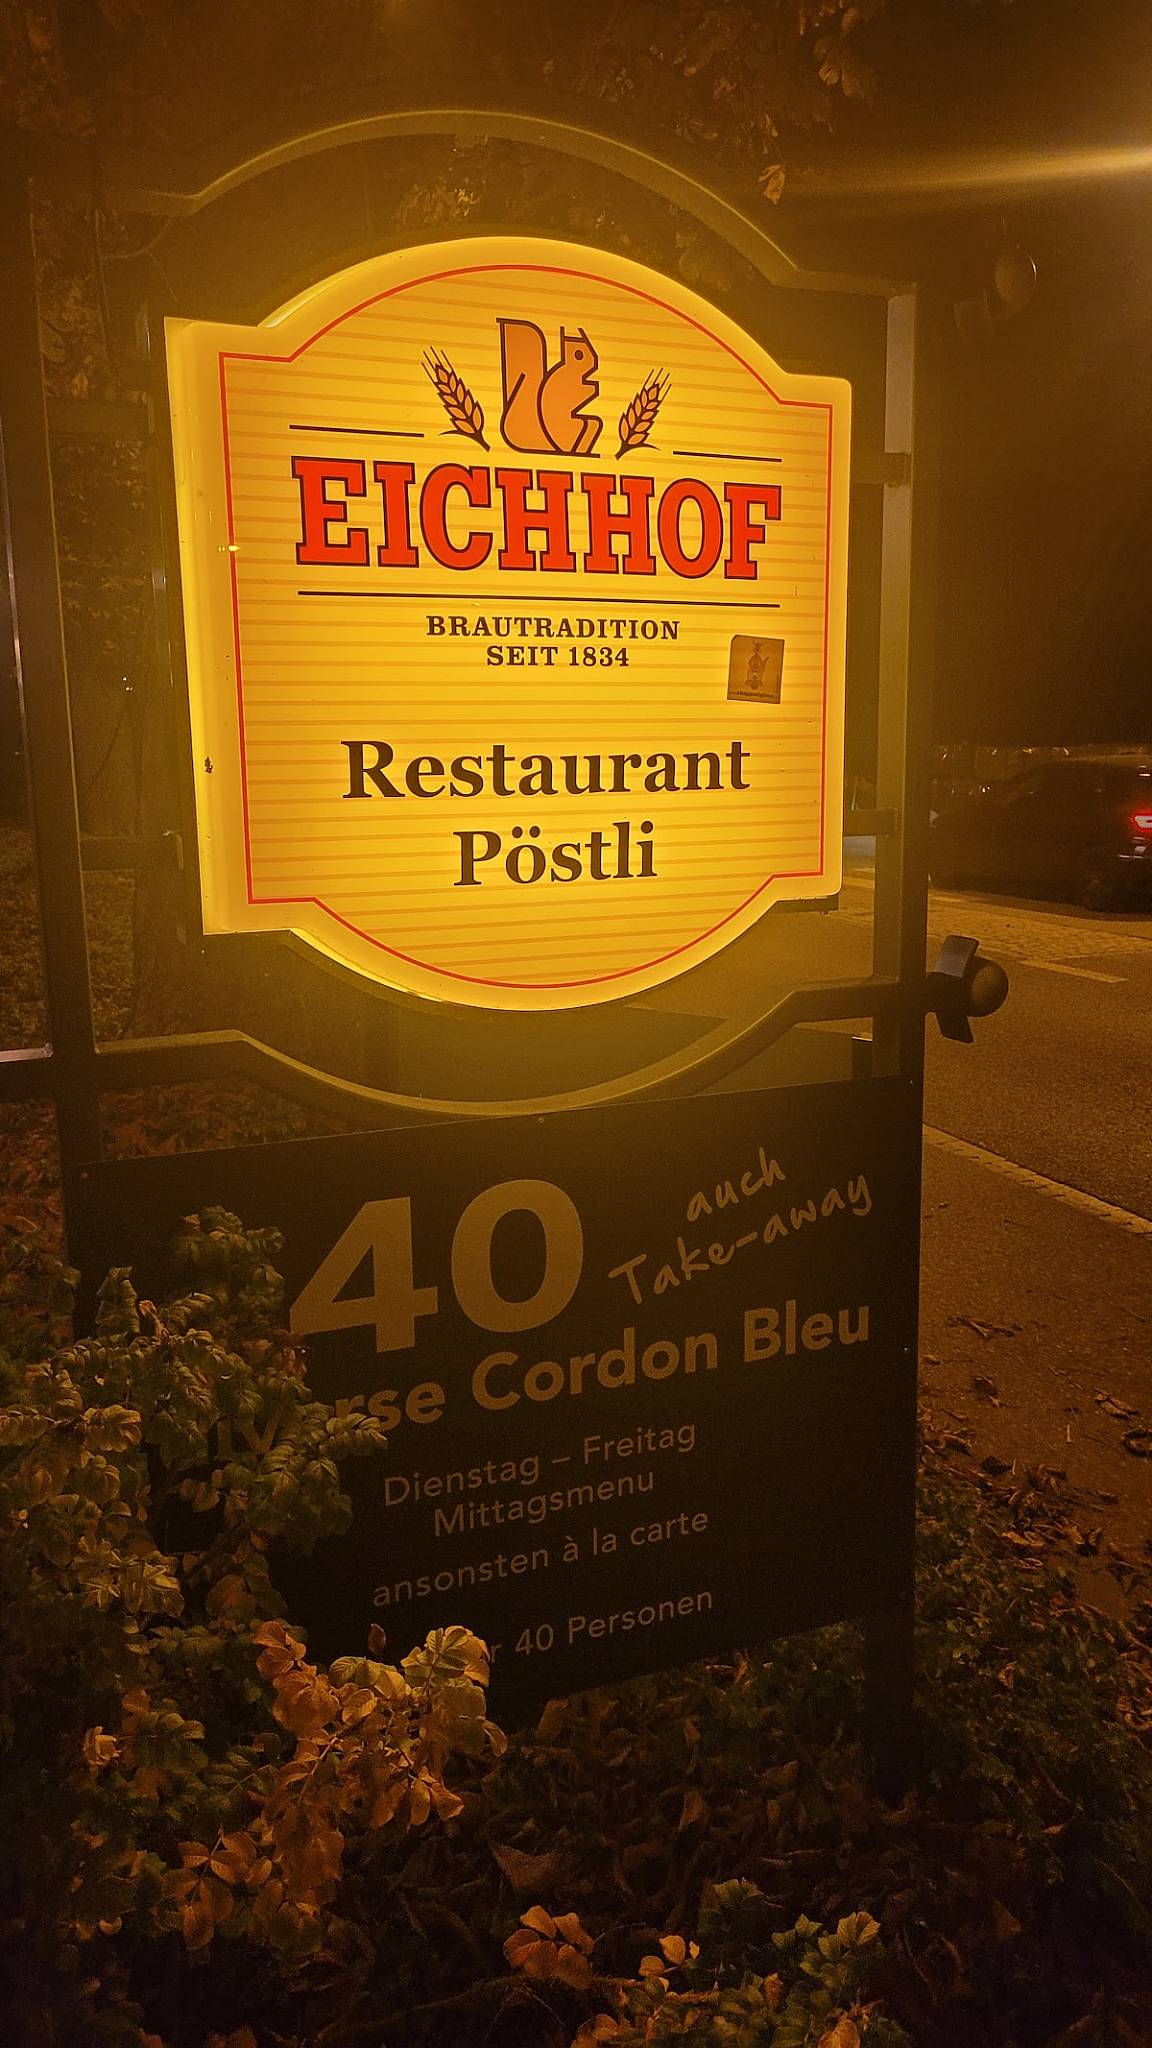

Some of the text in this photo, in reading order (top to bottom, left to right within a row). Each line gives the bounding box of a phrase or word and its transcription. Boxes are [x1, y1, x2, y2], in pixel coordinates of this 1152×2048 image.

[291, 455, 782, 581] EICHHOF
[426, 615, 680, 641] BRAUTRADITION
[486, 646, 630, 668] SEIT 1834
[341, 740, 751, 800] Restaurant
[453, 820, 658, 886] Pöstli
[686, 1147, 786, 1222] auch
[289, 1178, 584, 1353] 40
[608, 1173, 873, 1305] Take-away
[472, 1326, 718, 1411] Cordon
[744, 1300, 870, 1363] Bleu
[384, 1452, 541, 1507] Dienstag
[583, 1422, 698, 1466] Freitag
[433, 1471, 656, 1537] Mittagsmenu
[373, 1508, 711, 1608] ansonsten à la carte
[515, 1623, 554, 1657] 40
[567, 1588, 713, 1645] Personen
